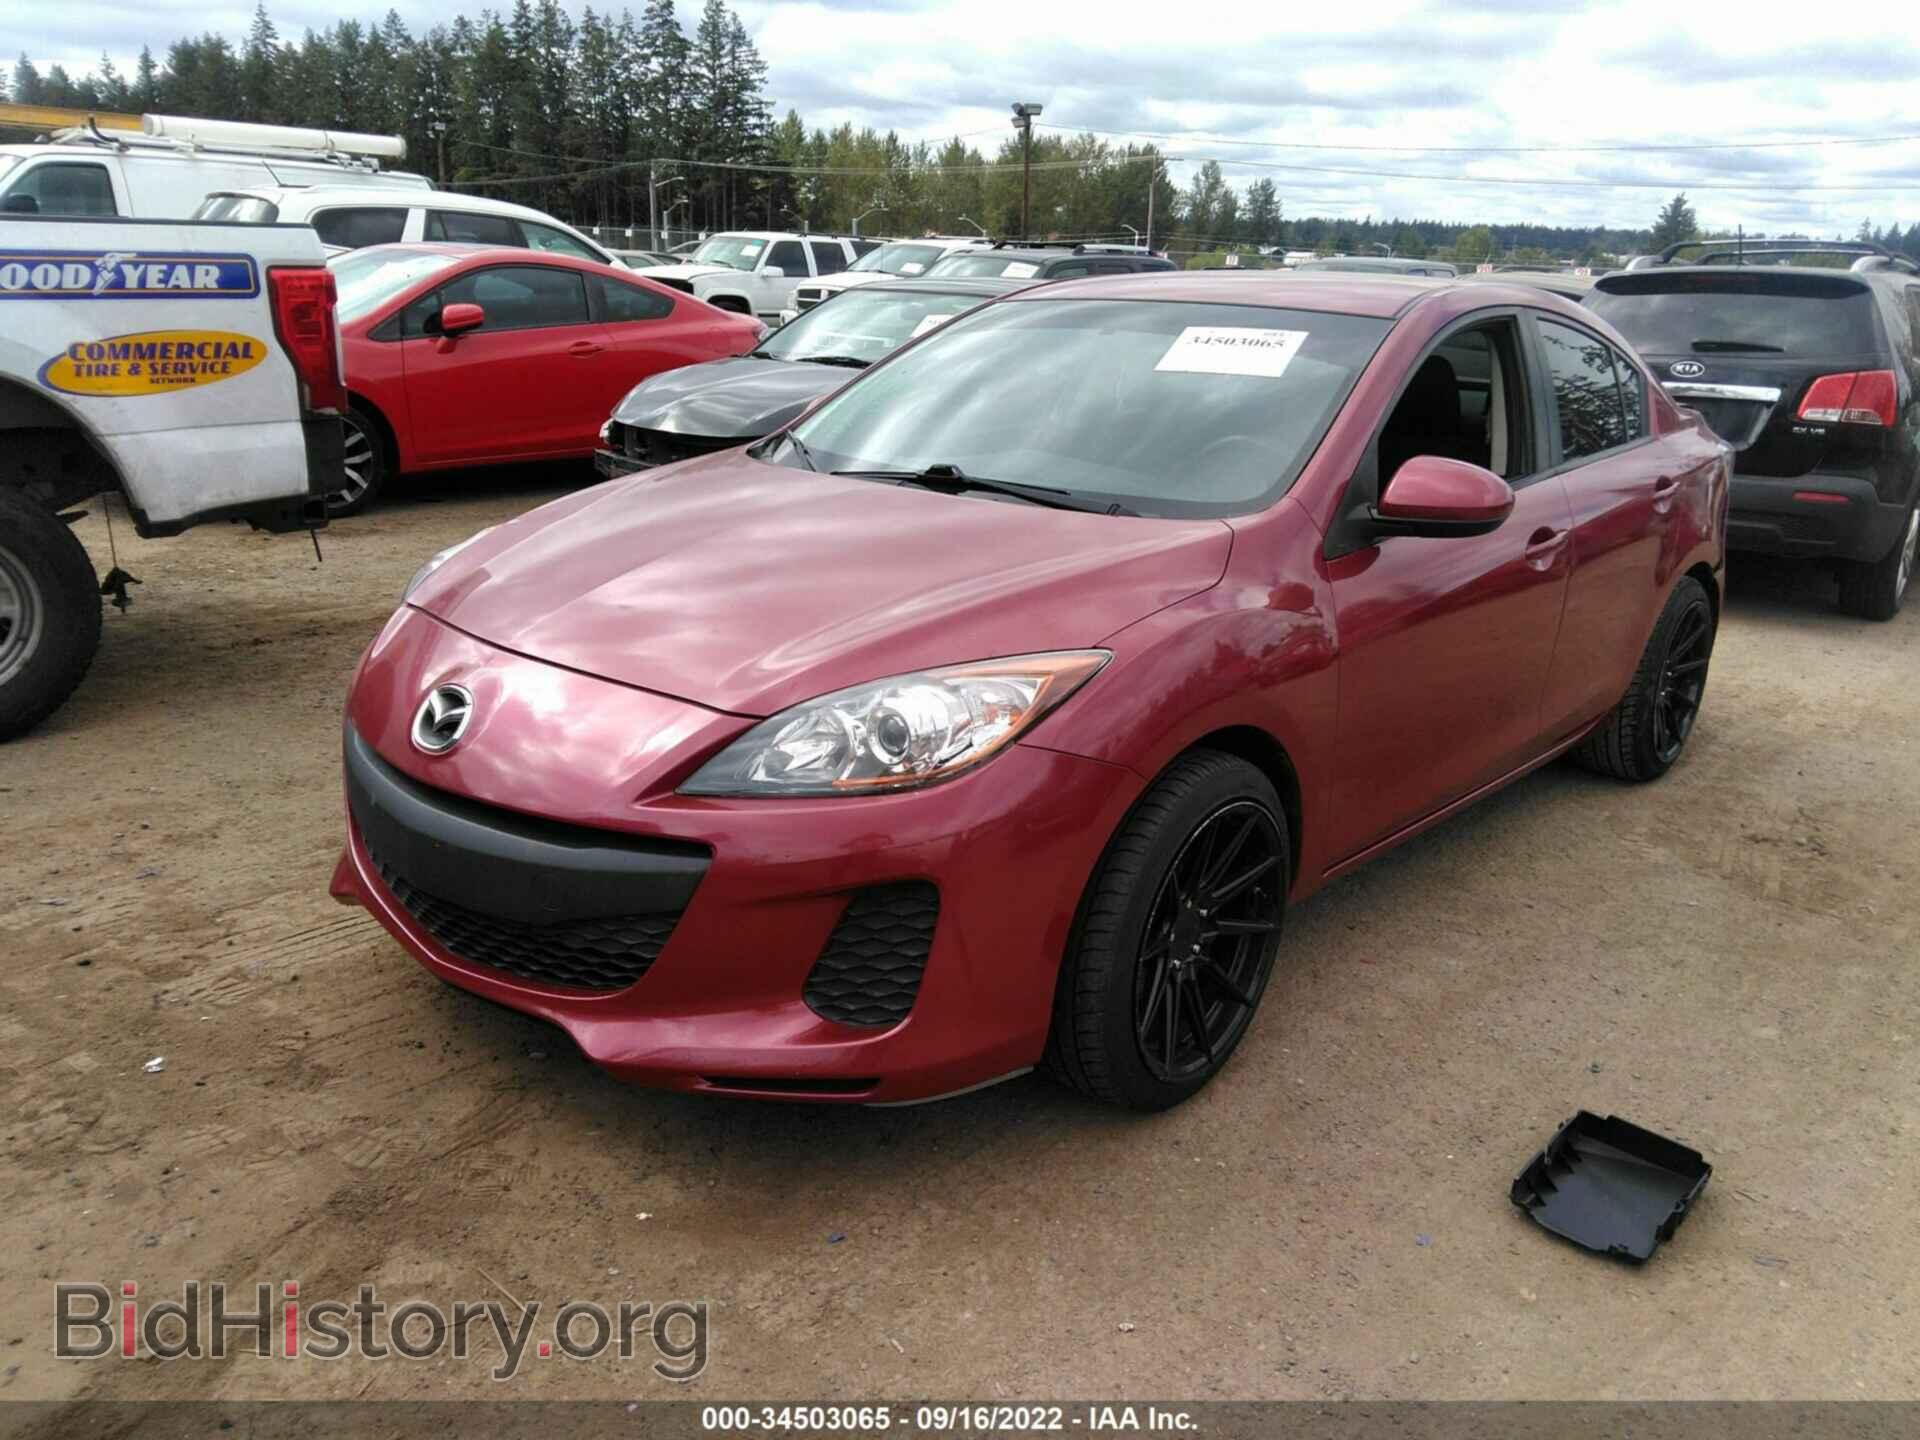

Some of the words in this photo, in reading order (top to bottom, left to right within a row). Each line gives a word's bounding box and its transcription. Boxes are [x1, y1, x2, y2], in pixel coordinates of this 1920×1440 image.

[68, 341, 254, 361] COMMERCIAL
[74, 362, 121, 377] TIRE
[127, 362, 142, 375] &
[148, 360, 232, 376] SERVICE
